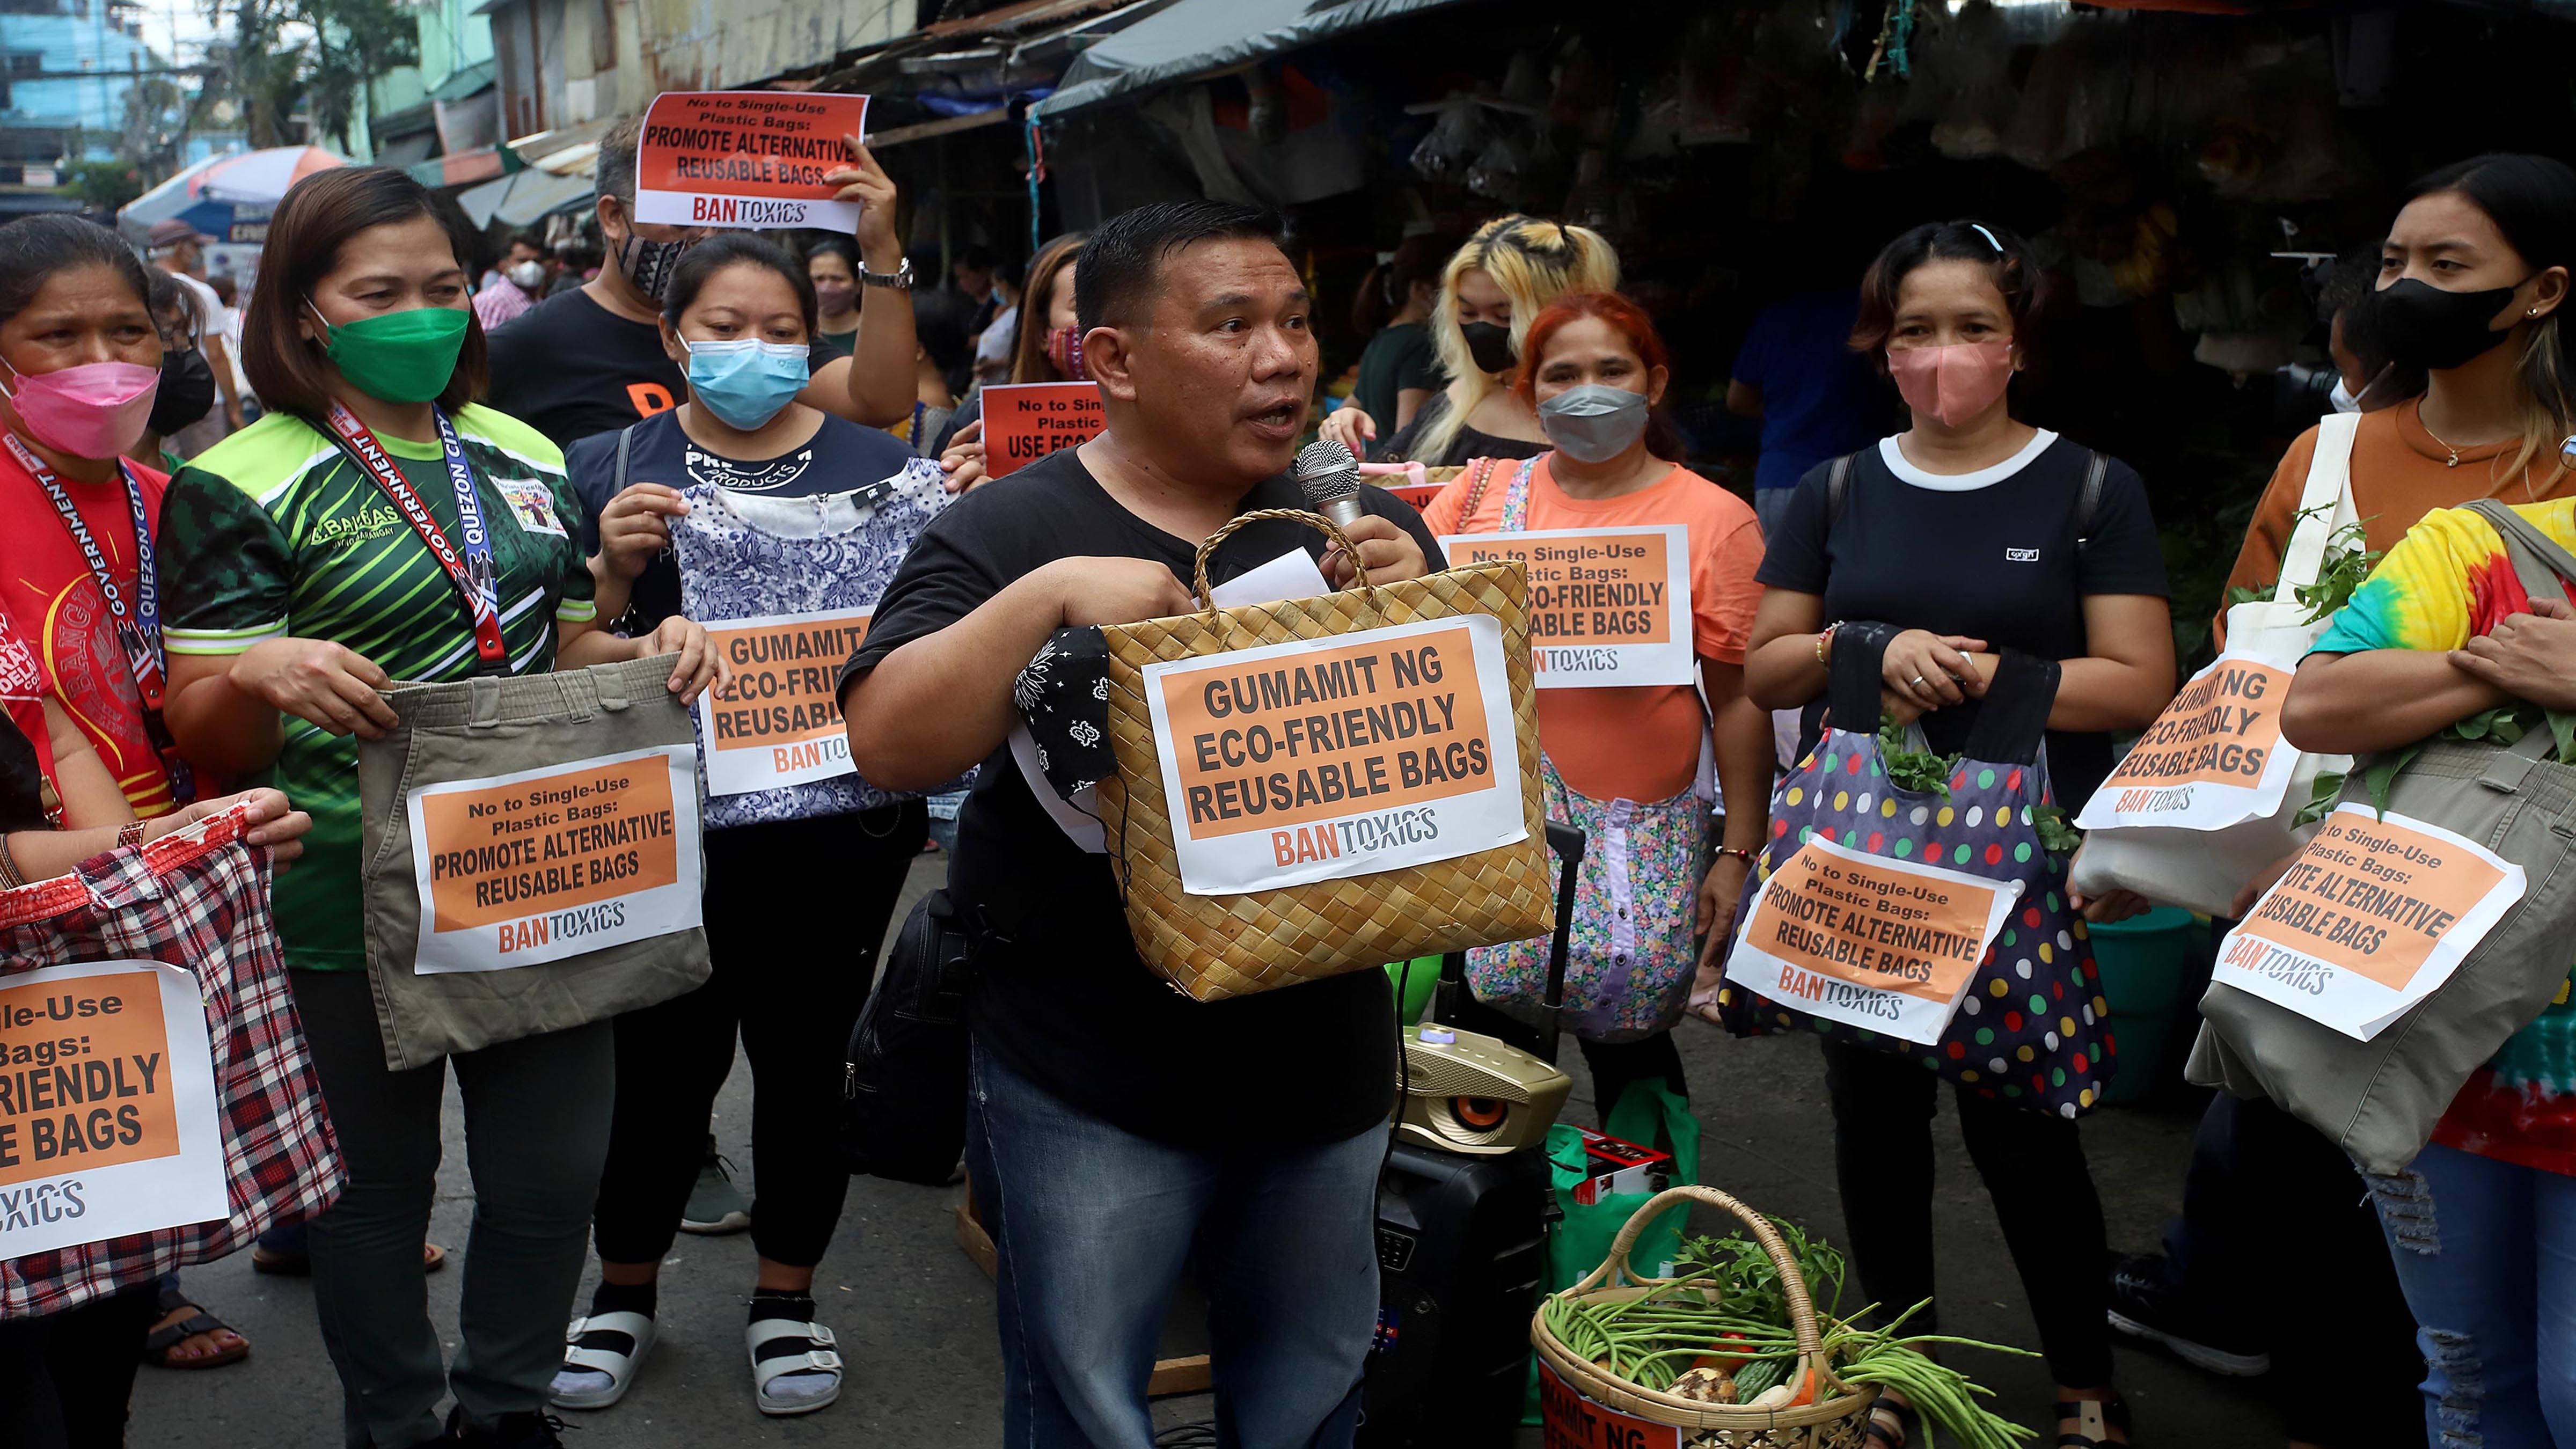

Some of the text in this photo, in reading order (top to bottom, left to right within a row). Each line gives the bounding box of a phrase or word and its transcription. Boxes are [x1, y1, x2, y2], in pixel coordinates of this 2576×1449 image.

[686, 98, 826, 114] No to Single-Use
[699, 112, 811, 133] Plastic Bags:
[645, 125, 855, 162] PROMOTE ALTERNATIVE
[677, 156, 825, 186] REUSABLE BAGS
[1018, 399, 1105, 412] No to Sin
[1038, 417, 1100, 429] Plastic
[1008, 435, 1045, 458] USE
[437, 412, 485, 545] QUEZON CITY
[703, 464, 796, 487] PRODUCTS
[351, 435, 456, 564] GOVERNMENT
[36, 473, 126, 617] GOVERNMENT
[126, 474, 157, 618] QUEZON CITY
[1472, 544, 1646, 564] No to Single-Use
[1570, 566, 1628, 583] Bags:
[1593, 610, 1651, 635] BAGS
[730, 626, 861, 665] GUMAMIT
[1203, 645, 1444, 720] GUMAMIT NG
[2220, 668, 2267, 700] NG
[1193, 692, 1455, 773] ECO-FRIENDLY
[2138, 705, 2262, 749] ECO-FRIENDLY
[1187, 737, 1488, 824] REUSABLE BAGS
[2195, 742, 2264, 777] BAGS
[468, 775, 630, 819] No to Single-Use
[492, 801, 619, 837] Plastic Bags:
[434, 810, 672, 881] PROMOTE ALTERNATIVE
[2306, 842, 2413, 885] Plastic Bags:
[2326, 824, 2342, 838] to
[2344, 828, 2443, 869] Single-Use
[476, 850, 640, 908] REUSABLE BAGS
[1801, 854, 1949, 906] No to Single-Use
[1805, 877, 1931, 921] Plastic Bags:
[1765, 880, 1979, 962] PROMOTE ALTERNATIVE
[2312, 872, 2456, 939] ALTERNATIVE
[1776, 919, 1934, 983] REUSABLE BAGS
[2326, 916, 2388, 955] BAGS
[0, 995, 123, 1032] le-Use
[31, 1104, 142, 1162] BAGS
[1605, 1422, 1646, 1449] NG
